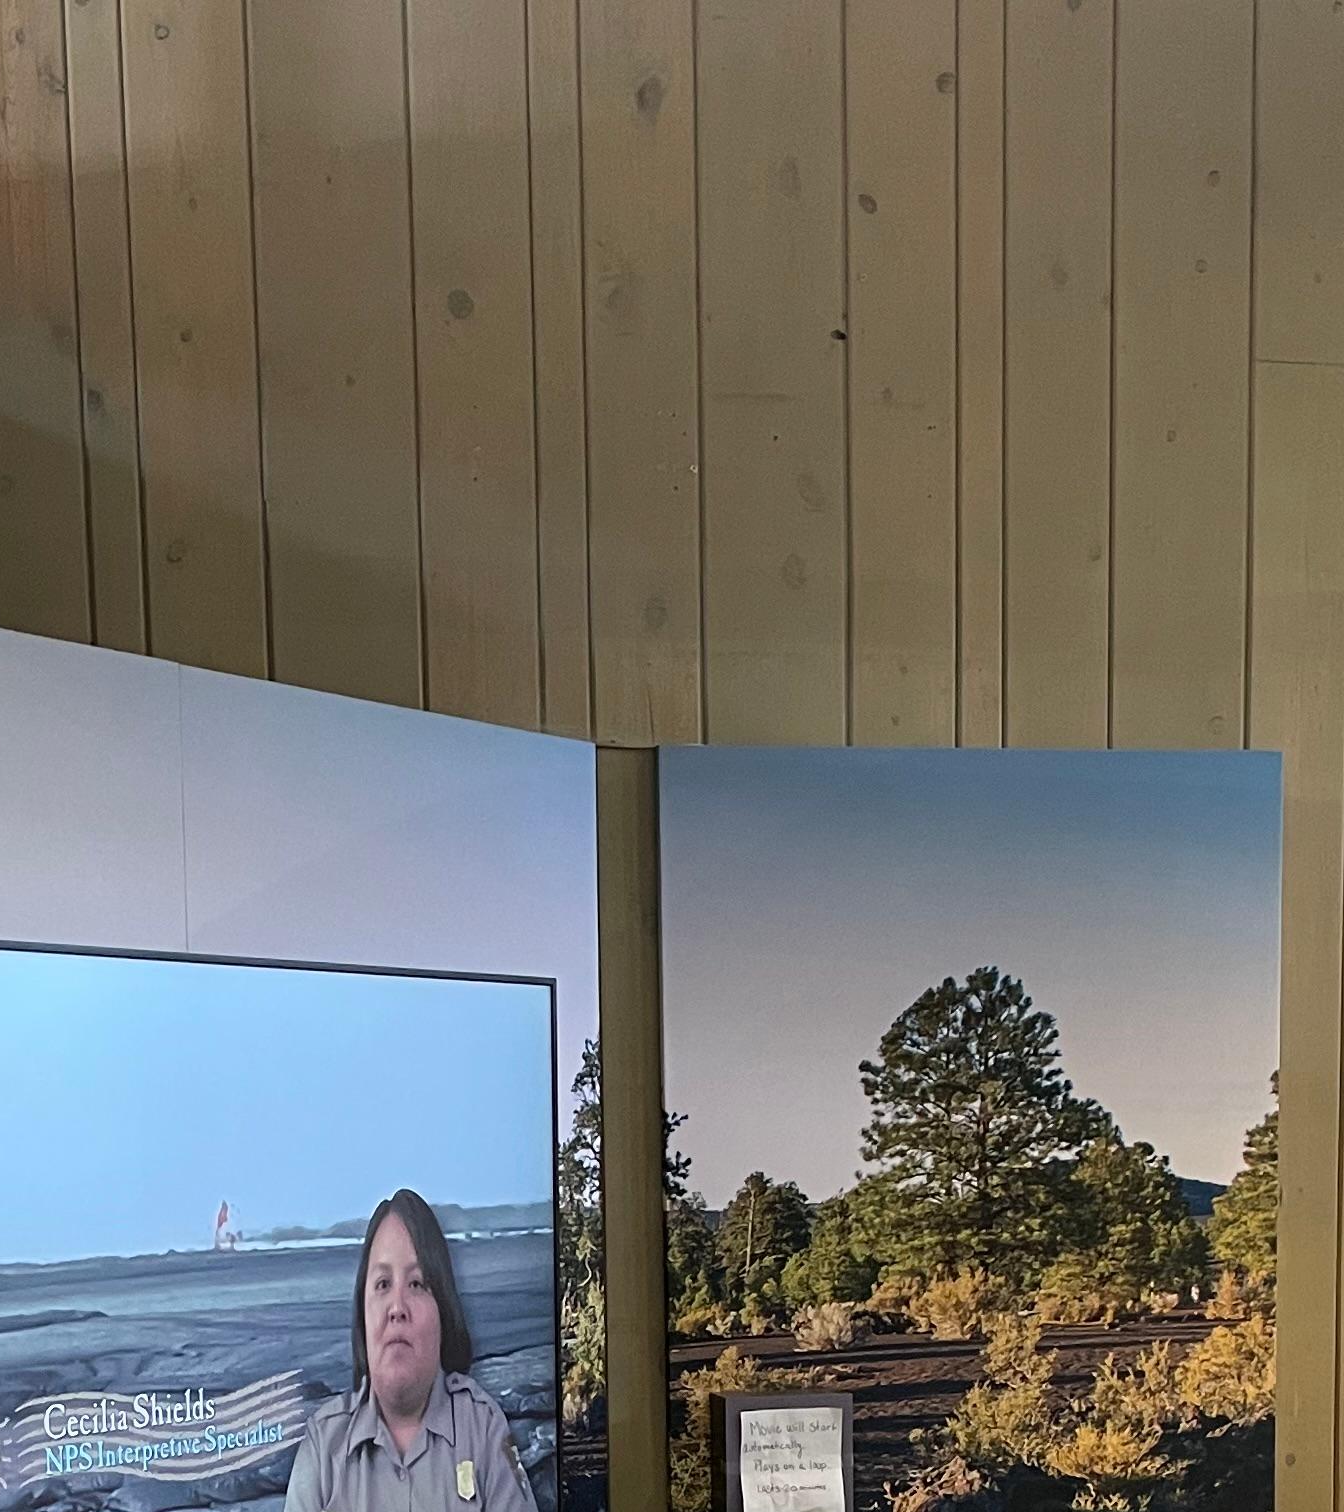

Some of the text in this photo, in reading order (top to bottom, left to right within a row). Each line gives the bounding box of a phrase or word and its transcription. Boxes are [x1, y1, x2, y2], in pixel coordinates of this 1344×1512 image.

[43, 1388, 215, 1440] Cecilia Shields
[750, 1421, 782, 1436] Movie
[787, 1421, 804, 1432] will
[45, 1420, 284, 1475] NPS Interpretive Specialist
[753, 1459, 779, 1473] Plays
